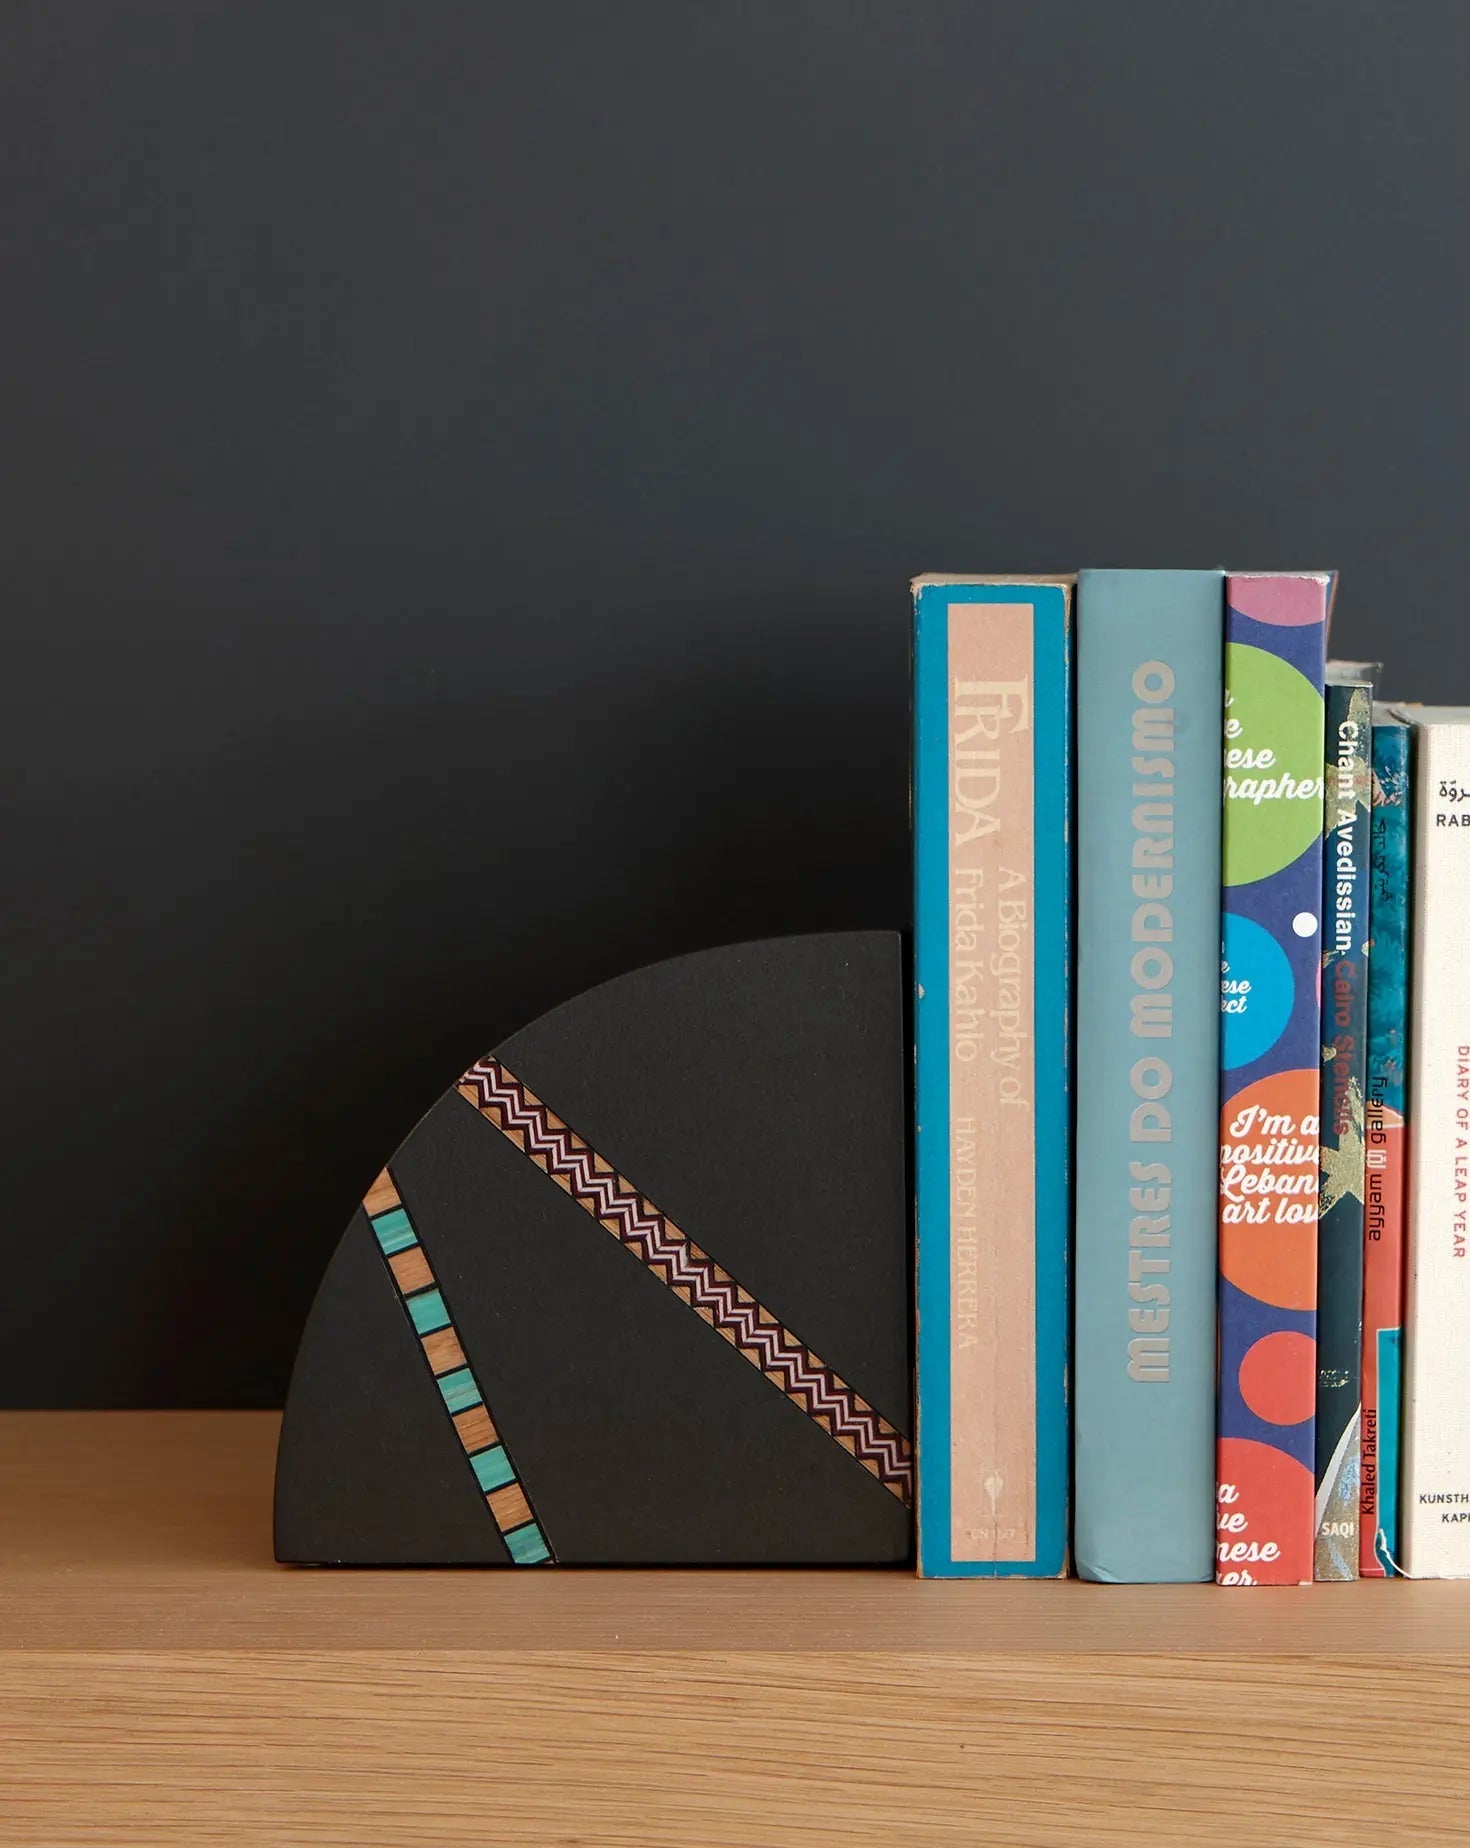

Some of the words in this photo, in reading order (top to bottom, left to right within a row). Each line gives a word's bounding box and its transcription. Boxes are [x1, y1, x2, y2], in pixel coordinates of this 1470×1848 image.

[953, 674, 1032, 847] FRIDA
[1224, 748, 1276, 769] ese
[1337, 720, 1360, 801] Chant
[1223, 772, 1325, 806] rapher
[1436, 814, 1470, 827] RAB
[1130, 660, 1176, 1039] MODERNISMO
[998, 866, 1027, 891] A
[955, 868, 984, 946] Frida
[955, 957, 990, 1063] Kahlo
[990, 898, 1028, 1070] Biography
[1334, 960, 1356, 1027] Cairo
[999, 1077, 1030, 1112] of
[1128, 1056, 1173, 1143] DO
[1456, 1046, 1470, 1101] DIARY
[1229, 1104, 1296, 1138] I'm
[1367, 1076, 1388, 1144] gallery
[1456, 1108, 1469, 1131] OF
[956, 1117, 977, 1218] HAYDEN
[1456, 1138, 1468, 1149] A
[1221, 1164, 1320, 1203] Leban
[1455, 1157, 1468, 1203] LEAP
[1222, 1197, 1271, 1224] art
[1274, 1197, 1319, 1224] lov
[1368, 1174, 1386, 1241] ayyam
[1453, 1210, 1467, 1259] YEAR
[957, 1226, 978, 1350] HERRERA
[1127, 1161, 1172, 1384] MESTRES
[1362, 1409, 1377, 1461] Takreti
[1361, 1462, 1376, 1515] Khaled
[1419, 1494, 1470, 1504] KUNSTH
[1321, 1521, 1355, 1537] SAQI
